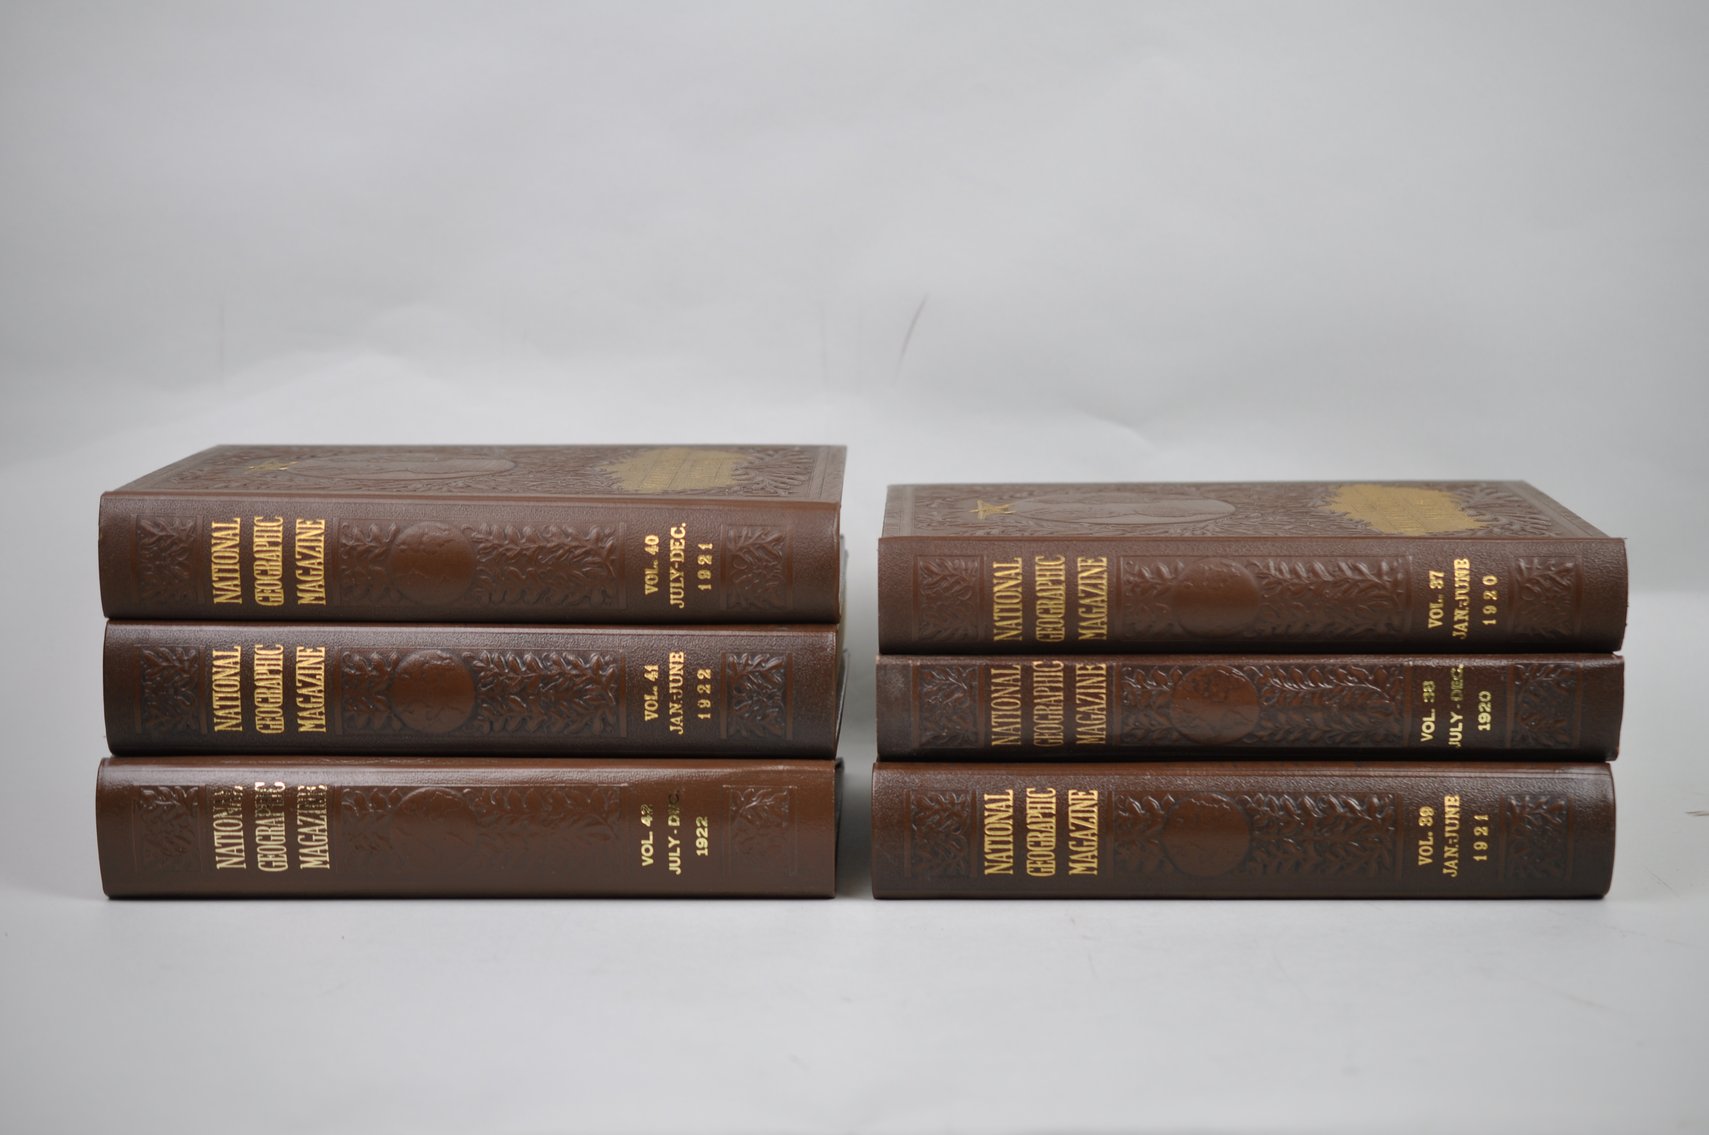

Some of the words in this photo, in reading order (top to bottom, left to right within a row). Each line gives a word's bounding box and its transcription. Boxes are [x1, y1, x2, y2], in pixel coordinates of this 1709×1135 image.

[211, 517, 243, 605] NATIONAL
[253, 515, 285, 607] GEOGRAPHIC
[295, 518, 328, 606] MAGAZINE
[645, 534, 660, 555] 40
[645, 559, 660, 596] VOL.
[670, 522, 688, 609] JULY-DEC.
[698, 543, 713, 591] 1921
[993, 557, 1023, 642] NATIONAL
[1035, 555, 1066, 644] GEOGRAPHIC
[1077, 556, 1108, 641] MAGAZINE
[1428, 594, 1445, 629] VOL.
[1482, 575, 1499, 626] 1920
[212, 645, 243, 733] NATIONAL
[253, 643, 285, 735] GEOGRAPHIC
[296, 646, 327, 734] MAGAZINE
[644, 664, 659, 682] 41
[644, 686, 659, 721] VOL.
[697, 668, 712, 720] 1922
[991, 664, 1022, 747] NATIONAL
[1033, 660, 1065, 747] GEOGRAPHIC
[1075, 663, 1107, 745] MAGAZINE
[1423, 680, 1436, 703] 38
[1478, 690, 1492, 732] 1920
[1421, 709, 1436, 742] VOL.
[296, 784, 331, 871] MAGAZINE
[695, 816, 709, 857] 1922
[984, 789, 1014, 876] NATIONAL
[1026, 787, 1057, 877] GEOGRAPHIC
[1068, 789, 1098, 876] MAGAZINE
[1418, 831, 1434, 866] VOL.
[1473, 814, 1489, 861] 1921
